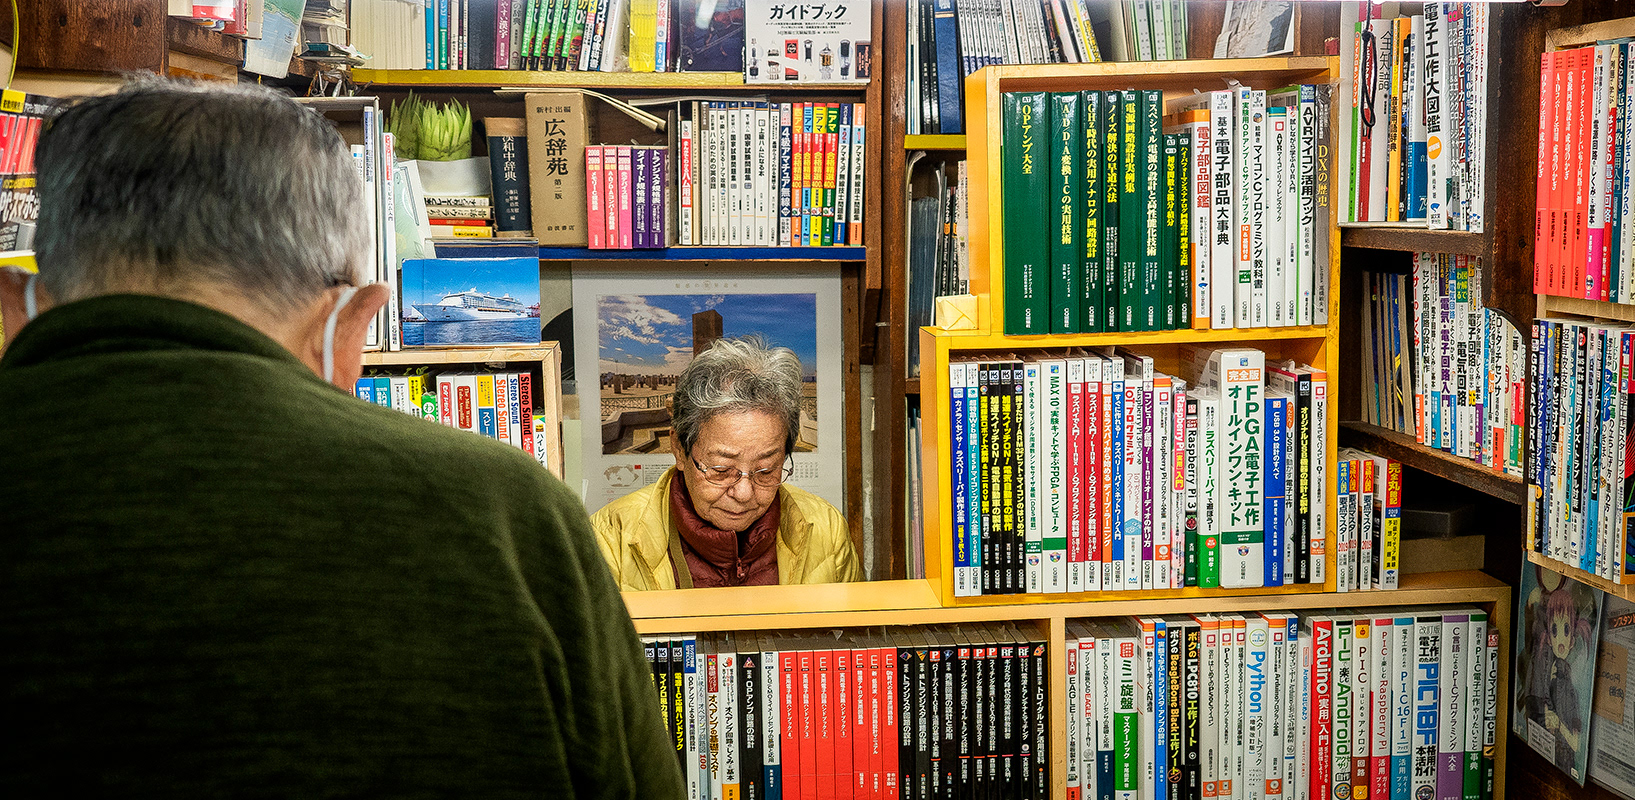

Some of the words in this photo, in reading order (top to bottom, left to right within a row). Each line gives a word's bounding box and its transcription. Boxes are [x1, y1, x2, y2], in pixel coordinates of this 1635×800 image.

[769, 3, 848, 20] ガイドブック
[1424, 3, 1441, 133] 電子工作大図鑑
[804, 108, 812, 132] 三アマ
[815, 107, 824, 132] 二アマ
[1022, 104, 1033, 175] OPアンプ大全
[1217, 116, 1228, 137] 基本
[544, 118, 569, 177] 広辞苑
[781, 127, 793, 209] 4級アマチュア無線
[1107, 105, 1118, 203] ノイズ解決の早道六法
[1125, 103, 1136, 193] 電源回路設計実例集
[1196, 126, 1210, 208] 電子部品図鑑
[1301, 106, 1314, 226] AVRマイコン活用ブック
[554, 179, 562, 199] 第二版
[1086, 104, 1098, 258] GHz時代の実用アナログ回路設計
[1147, 104, 1158, 257] スペシャル電源の設計と高性能化技術
[1214, 138, 1230, 245] 電子部品大事典
[1317, 145, 1329, 207] DXの歴史
[1253, 145, 1263, 289] マイコンCプログラミング教科書
[1440, 298, 1451, 408] 電気・電子回路入門
[1456, 341, 1467, 407] 電気回路
[496, 379, 506, 409] Stereo
[510, 378, 518, 401] Stereo
[520, 376, 530, 405] Stereo
[1050, 376, 1060, 396] MAX
[1228, 370, 1261, 382] 完全版
[498, 410, 509, 439] Sound
[511, 402, 520, 424] Sound
[522, 406, 532, 435] Sound
[1174, 395, 1186, 442] Raspberry
[1273, 412, 1281, 428] USB
[1159, 436, 1168, 472] Raspberry
[1176, 443, 1186, 452] Pi
[1186, 430, 1197, 485] Raspberry
[1227, 385, 1243, 527] オールインワン・キット
[1244, 385, 1260, 526] FPGA電子工作
[1187, 488, 1197, 498] Pi
[1387, 462, 1401, 505] 完全丸暗記
[1338, 543, 1348, 552] 2019
[1361, 541, 1372, 550] 2019
[1169, 630, 1180, 653] ボクの
[1187, 631, 1199, 657] ボクの
[1418, 625, 1440, 635] 改訂版
[1418, 636, 1439, 647] 電子
[1418, 647, 1440, 657] 工作
[1001, 648, 1013, 657] RF
[1018, 648, 1029, 657] RF
[1316, 626, 1332, 695] Arduino
[1120, 660, 1134, 710] ミニ旋盤
[1168, 654, 1179, 708] BeagleBone
[1187, 658, 1199, 699] LPC810
[1246, 651, 1266, 713] Python
[1449, 627, 1460, 751] C言語によるPICプログラミング
[674, 672, 684, 751] 電源IC応用ハンドブック
[746, 680, 755, 749] OPアンプ回路の設計
[903, 674, 912, 746] トランジスタ回路の設計
[918, 680, 927, 752] トランジスタ回路の設計
[1170, 709, 1180, 733] Black
[1187, 700, 1198, 747] 工作ノート
[1336, 683, 1351, 756] Android
[1376, 679, 1389, 738] Raspberry
[1416, 663, 1440, 746] PIC18F
[1122, 715, 1131, 759] マスターブック
[1170, 733, 1180, 774] 工作ノート
[1255, 715, 1264, 766] スタートブック
[1415, 747, 1437, 757] 本格
[1415, 757, 1437, 767] 活用
[1448, 754, 1457, 772] 大全
